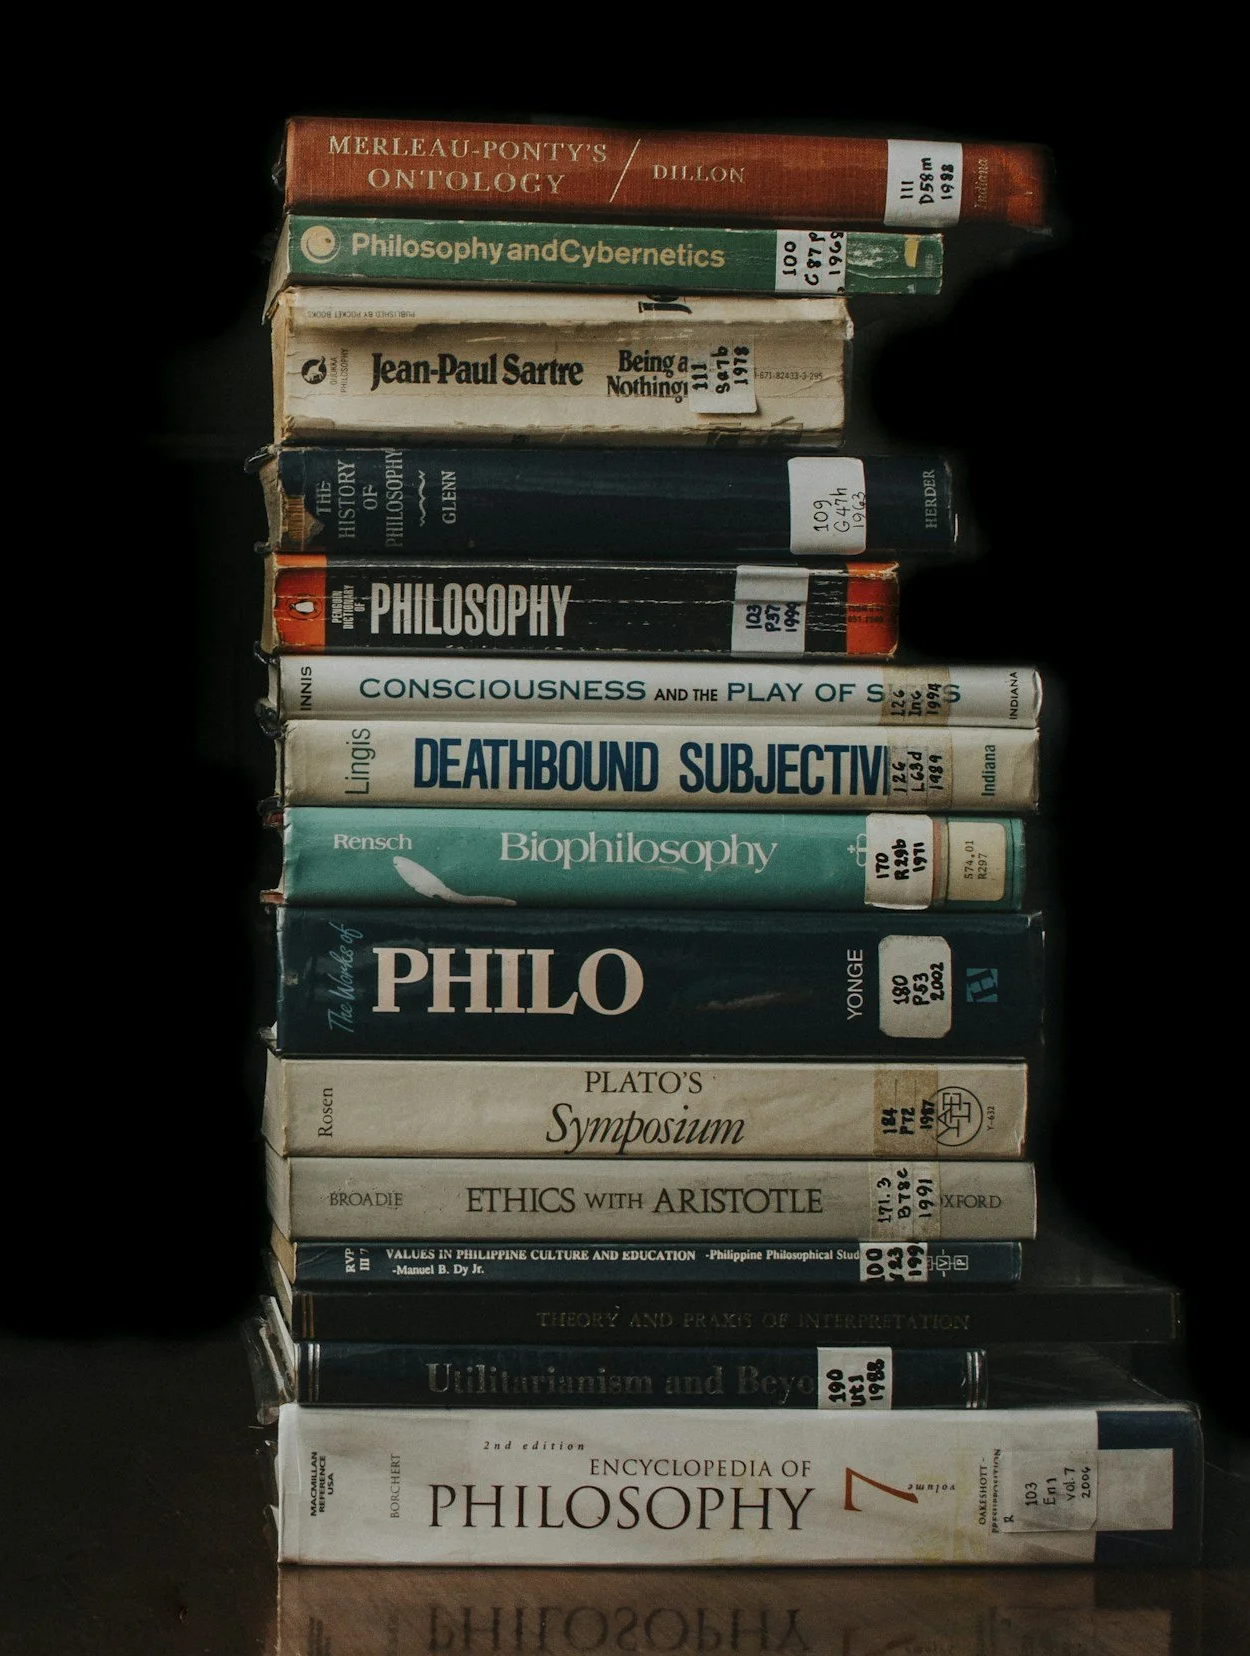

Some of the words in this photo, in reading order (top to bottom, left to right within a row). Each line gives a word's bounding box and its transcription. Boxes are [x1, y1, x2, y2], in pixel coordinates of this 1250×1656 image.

[328, 135, 607, 163] MERLEAU-PONTY'S
[367, 168, 566, 195] ONTOLOGY
[652, 163, 747, 184] DILLON
[940, 164, 955, 199] 1988
[973, 157, 990, 210] Indiana
[782, 241, 797, 276] 100
[334, 310, 362, 319] POCKET
[364, 310, 374, 319] BY
[375, 310, 416, 319] PUBLISHED
[340, 347, 349, 393] PHILOSOPHY
[370, 352, 498, 391] Jean-Paul
[502, 353, 585, 386] Sartre
[618, 350, 674, 378] Being
[733, 346, 750, 385] 1978
[315, 481, 331, 516] THE
[337, 459, 356, 539] HISTORY
[362, 484, 379, 511] OF
[385, 448, 403, 549] PHILOSOPHY
[441, 470, 458, 525] GLENN
[852, 491, 866, 529] 1963
[922, 469, 938, 529] HERDER
[813, 500, 832, 532] 109
[332, 589, 343, 625] PENGUIN
[342, 584, 354, 630] DICTIONARY
[354, 598, 366, 613] OF
[369, 582, 573, 637] PHILOSOPHY
[745, 604, 763, 630] 103
[300, 666, 312, 711] INNIS
[359, 678, 647, 701] CONSCIOUSNESS
[653, 687, 688, 702] AND
[693, 687, 719, 702] THE
[726, 682, 803, 703] PLAY
[815, 683, 857, 703] OF
[1008, 671, 1019, 720] INDIANA
[344, 728, 375, 795] Lingis
[414, 737, 659, 793] DEATHBOUND
[981, 744, 997, 797] Indiana
[332, 834, 413, 851] Rensch
[500, 831, 779, 874] Biophilosophy
[964, 840, 975, 880] 574.01
[875, 852, 890, 880] 170
[977, 853, 989, 880] R297
[328, 921, 364, 944] of
[326, 945, 356, 1001] Works
[371, 946, 645, 1016] PHILO
[846, 949, 864, 1020] YONGE
[892, 975, 911, 1005] 180
[930, 961, 945, 1001] 2002
[327, 1003, 355, 1033] The
[584, 1071, 703, 1094] PLATO'S
[317, 1087, 334, 1139] Rosen
[546, 1103, 747, 1155] Symposium
[986, 1105, 996, 1132] Y-632
[329, 1192, 404, 1207] BROADIE
[466, 1186, 576, 1214] ETHICS
[584, 1192, 644, 1209] WITH
[652, 1187, 824, 1214] ARISTOTLE
[916, 1178, 934, 1218] 1991
[345, 1247, 356, 1273] RVP
[385, 1248, 435, 1260] VALUES
[438, 1248, 453, 1260] IN
[456, 1248, 527, 1261] PHILIPPINE
[530, 1249, 590, 1261] CULTURE
[592, 1249, 619, 1261] AND
[621, 1249, 697, 1261] EDUCATION
[765, 1249, 834, 1263] Philosophical
[438, 1264, 450, 1275] B.
[453, 1263, 469, 1277] Dy
[471, 1262, 486, 1275] Jr.
[536, 1311, 618, 1328] THEORY
[629, 1311, 674, 1328] AND
[682, 1311, 753, 1328] PRAXIS
[762, 1311, 790, 1328] OF
[796, 1311, 972, 1330] INTERPRETATION
[424, 1362, 654, 1394] Utilitarianism
[665, 1365, 725, 1394] and
[827, 1368, 846, 1403] 190
[483, 1440, 512, 1451] 2nd
[522, 1441, 585, 1452] edition
[310, 1451, 318, 1517] MACMILLAN
[318, 1455, 326, 1513] REFERENCE
[390, 1453, 401, 1519] BORCHERT
[589, 1459, 773, 1478] ENCYCLOPEDIA
[782, 1460, 812, 1479] OF
[844, 1466, 919, 1512] 7
[908, 1483, 957, 1494] volume
[978, 1464, 989, 1526] OAKESHOTT
[1024, 1481, 1039, 1507] 103
[428, 1483, 816, 1531] PHILOSOPHY
